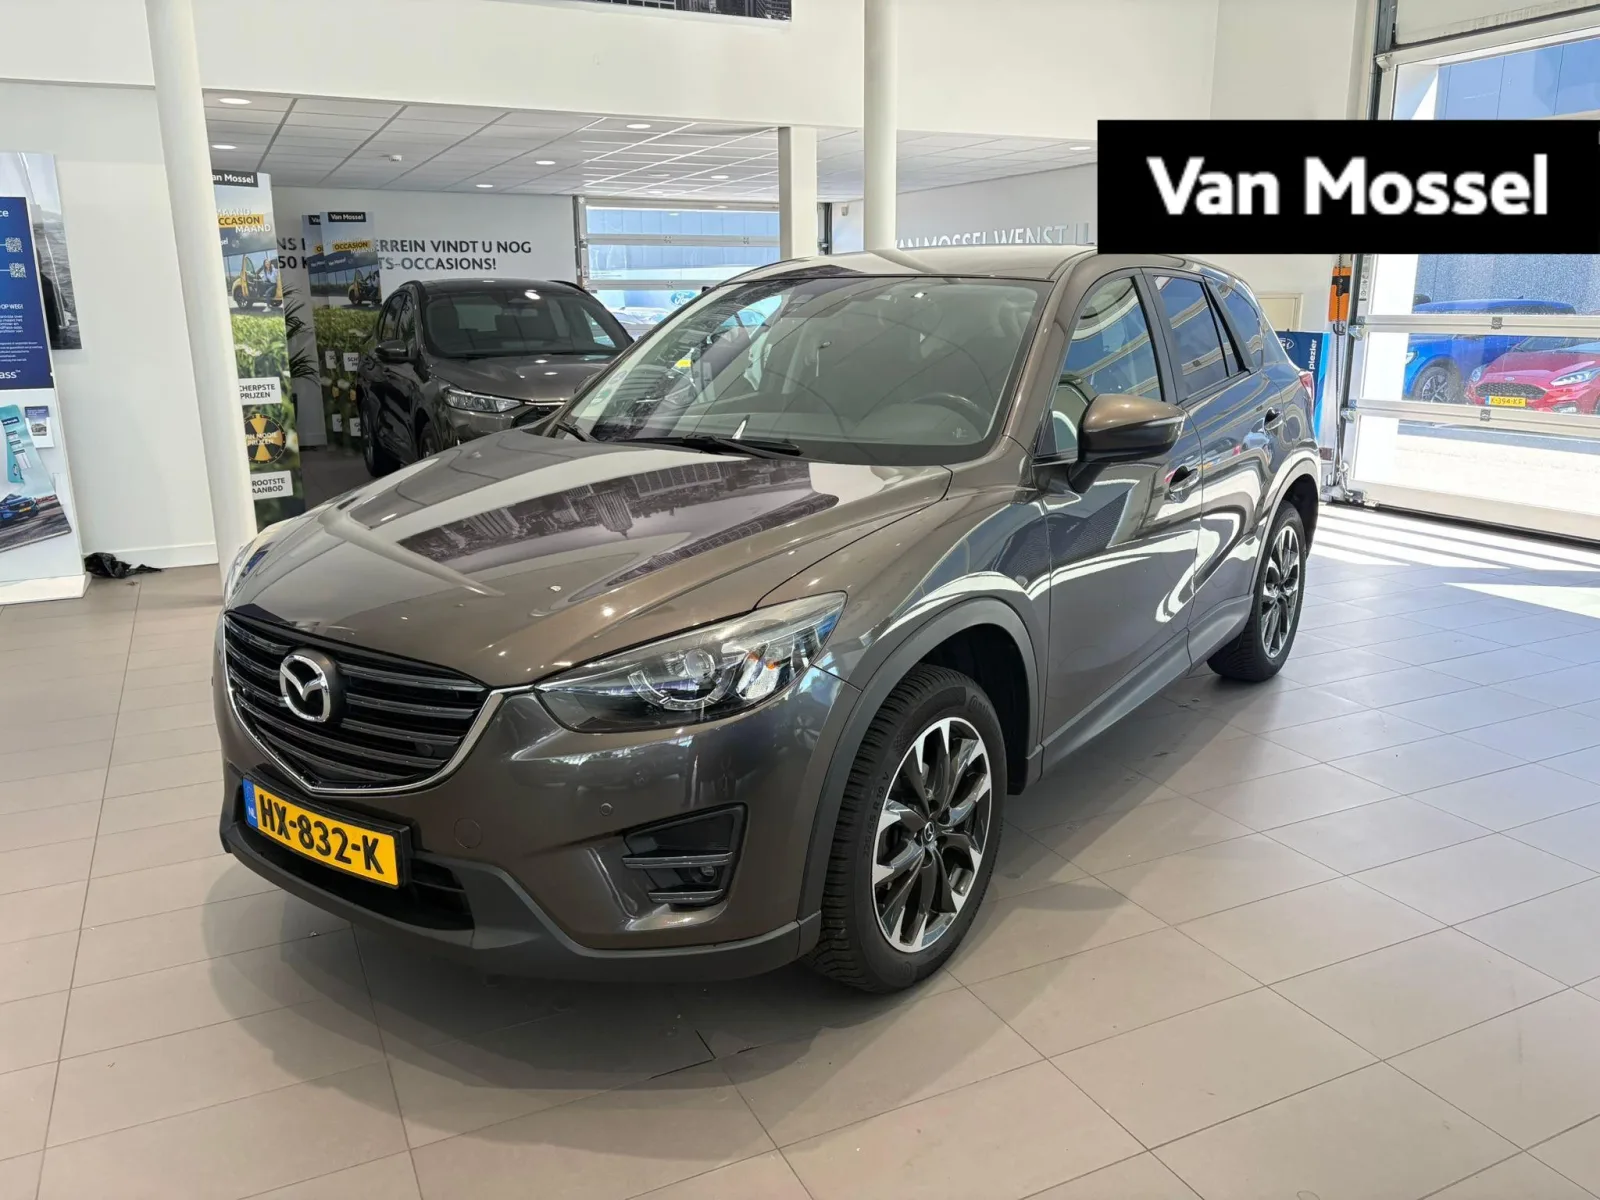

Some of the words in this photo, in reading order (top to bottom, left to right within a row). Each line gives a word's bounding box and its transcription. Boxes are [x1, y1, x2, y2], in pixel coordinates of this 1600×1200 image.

[224, 173, 254, 183] Mossel
[235, 224, 271, 233] MAAND
[335, 241, 368, 250] OCCASION
[431, 240, 480, 253] VINDT
[483, 241, 494, 253] U
[497, 241, 532, 254] NOG
[259, 793, 385, 876] HX-832-K
